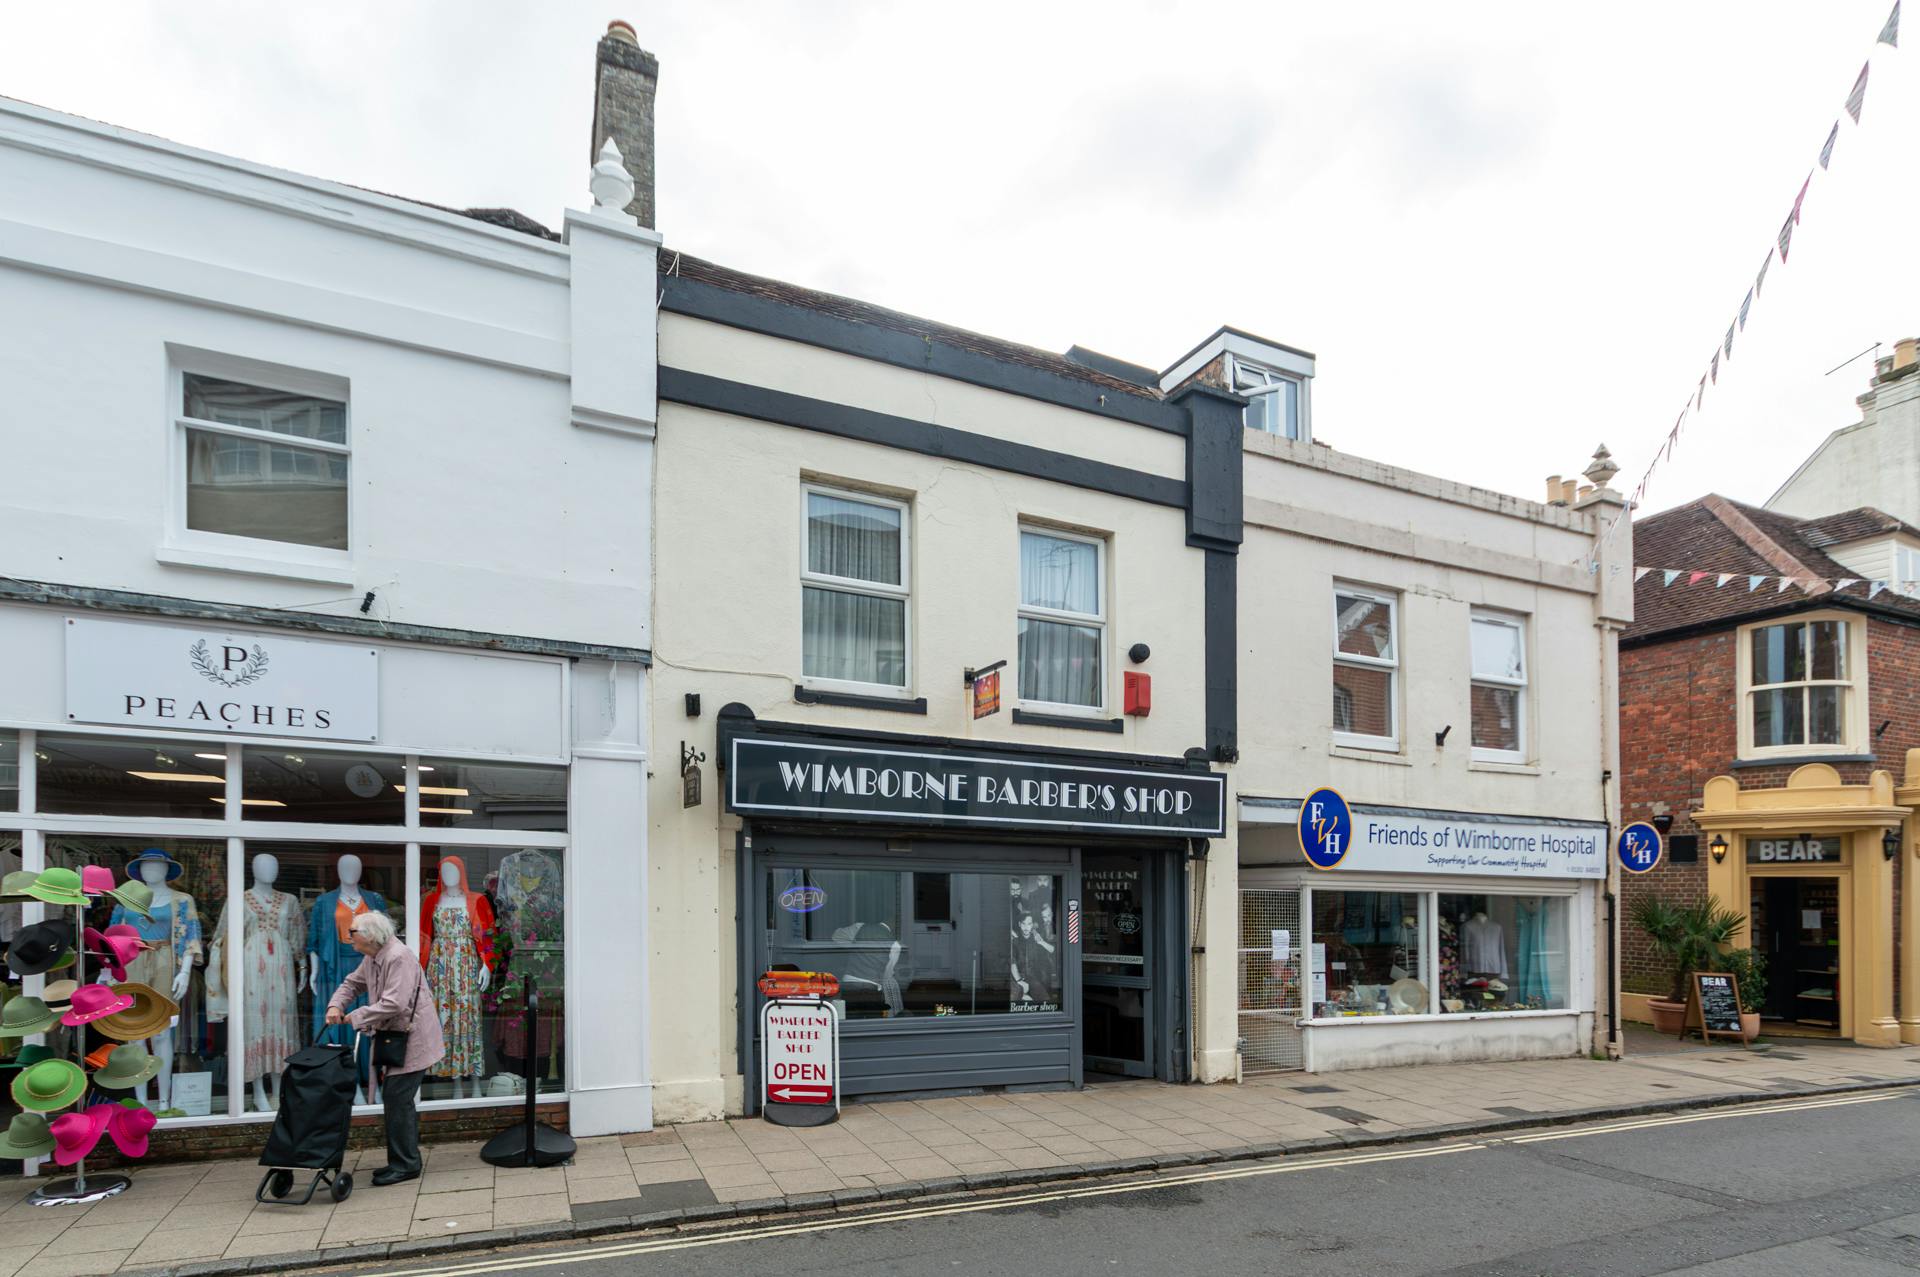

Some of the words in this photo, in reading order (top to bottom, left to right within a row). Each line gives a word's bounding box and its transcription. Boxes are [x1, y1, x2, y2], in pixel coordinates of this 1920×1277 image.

[221, 645, 248, 671] P
[123, 694, 331, 729] PEACHES
[778, 761, 968, 802] WIMBORNE
[977, 775, 1116, 812] BARBER'S
[1123, 786, 1193, 815] SHOP
[1368, 823, 1428, 847] Friends
[1433, 826, 1451, 848] of
[1454, 828, 1537, 853] Wimborne
[1541, 833, 1597, 858] Hospital
[1759, 840, 1823, 861] BEAR
[1427, 853, 1466, 869] Supporting
[1481, 856, 1519, 872] Community
[1520, 856, 1548, 871] Hospital
[781, 890, 825, 907] OPEN
[1701, 976, 1728, 987] BEAR
[1010, 1001, 1039, 1012] Barber
[1040, 1001, 1059, 1012] shop
[769, 1016, 828, 1026] WIMBORNE
[777, 1030, 821, 1040] BARBER
[785, 1044, 814, 1053] SHOP
[773, 1062, 826, 1080] OPEN
